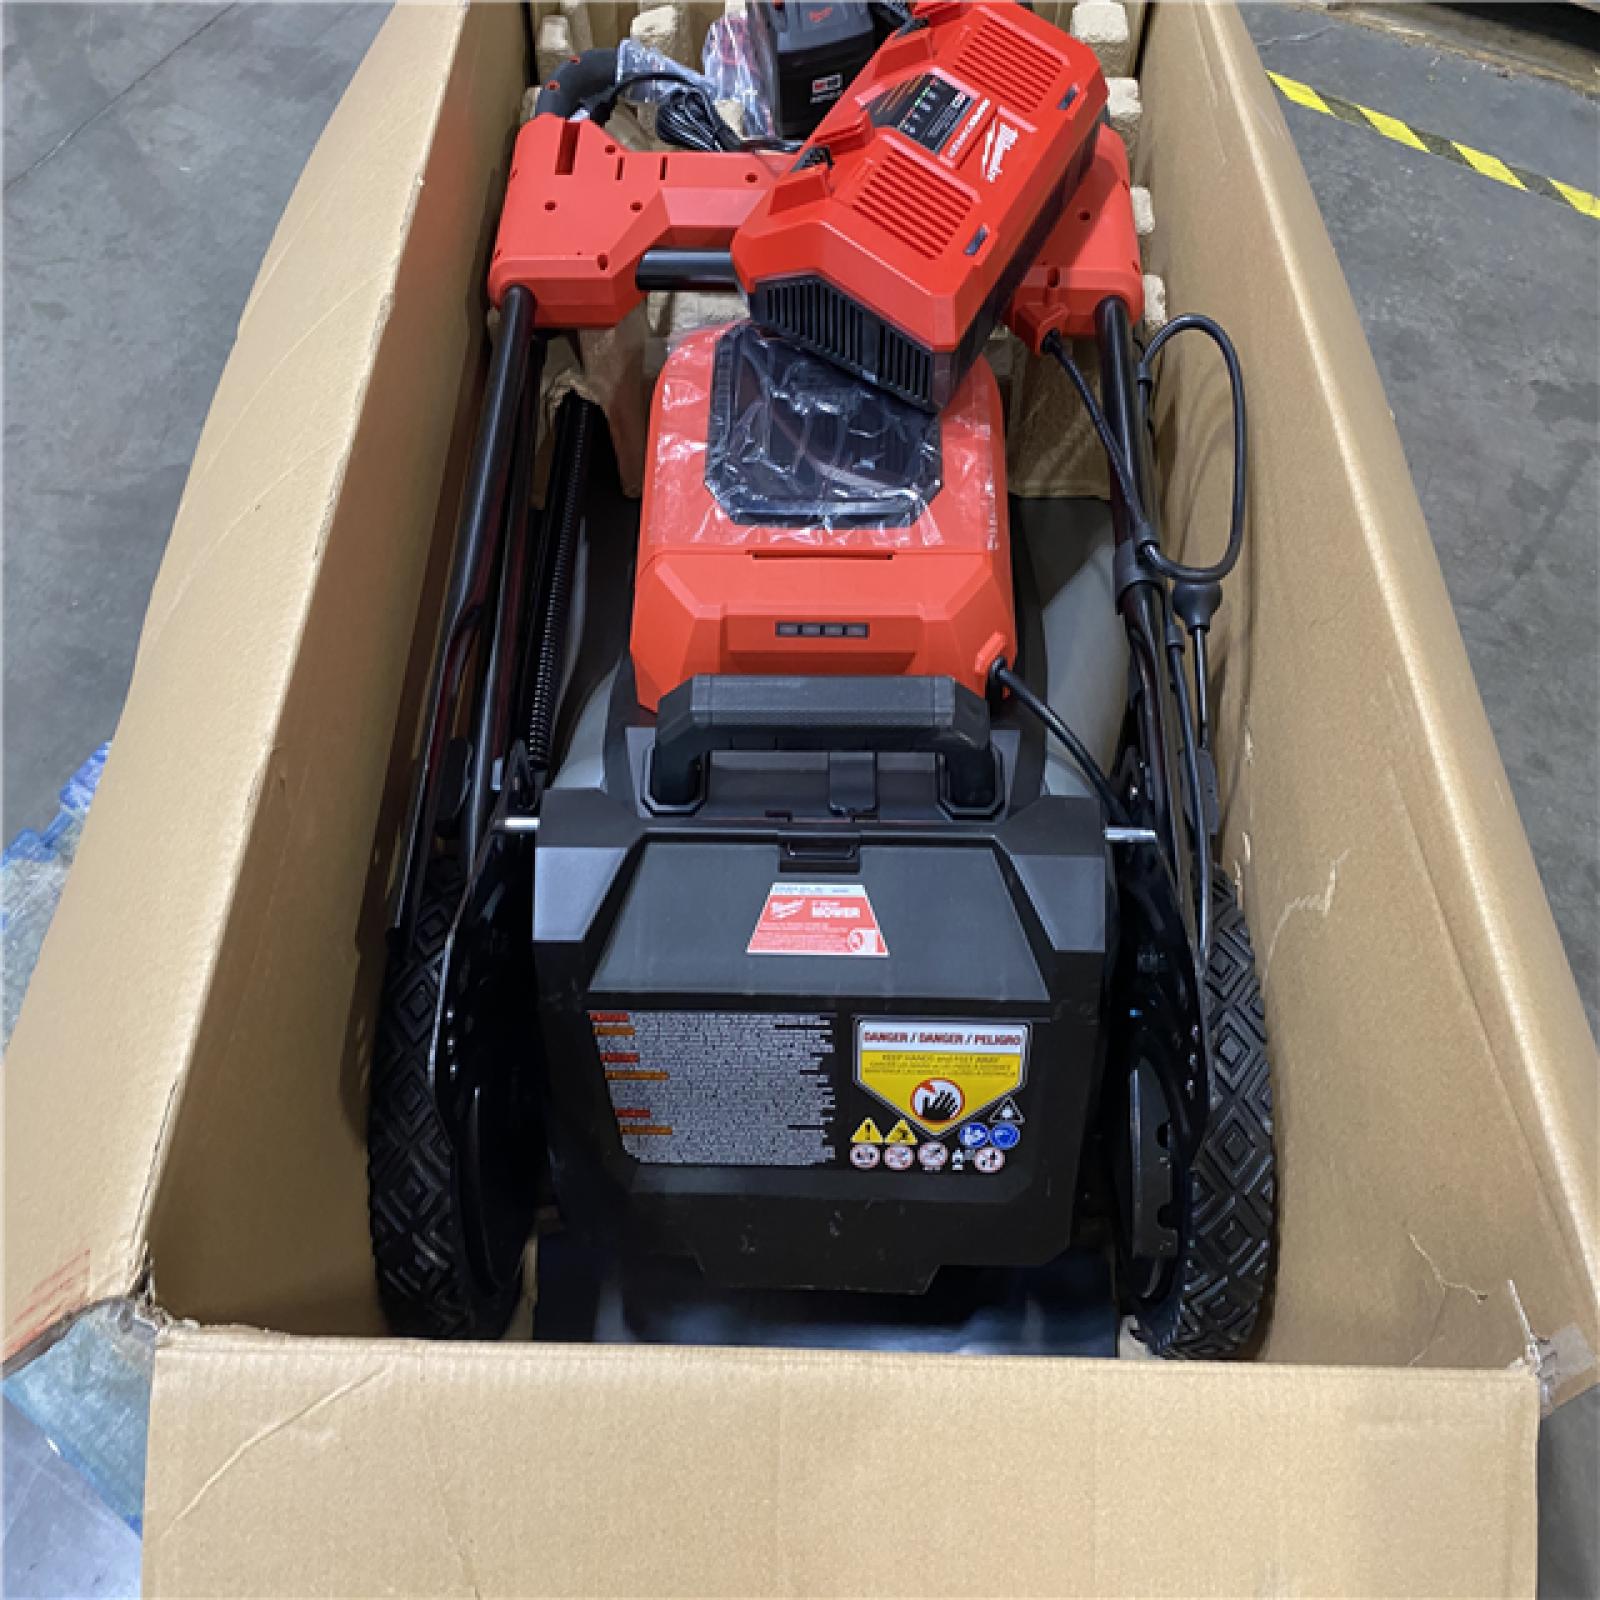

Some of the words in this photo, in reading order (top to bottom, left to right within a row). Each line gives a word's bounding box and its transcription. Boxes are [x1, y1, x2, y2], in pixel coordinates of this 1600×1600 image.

[864, 1032, 908, 1043] DANGER
[919, 1032, 963, 1044] DANGER
[974, 1034, 1021, 1046] PELIGRO
